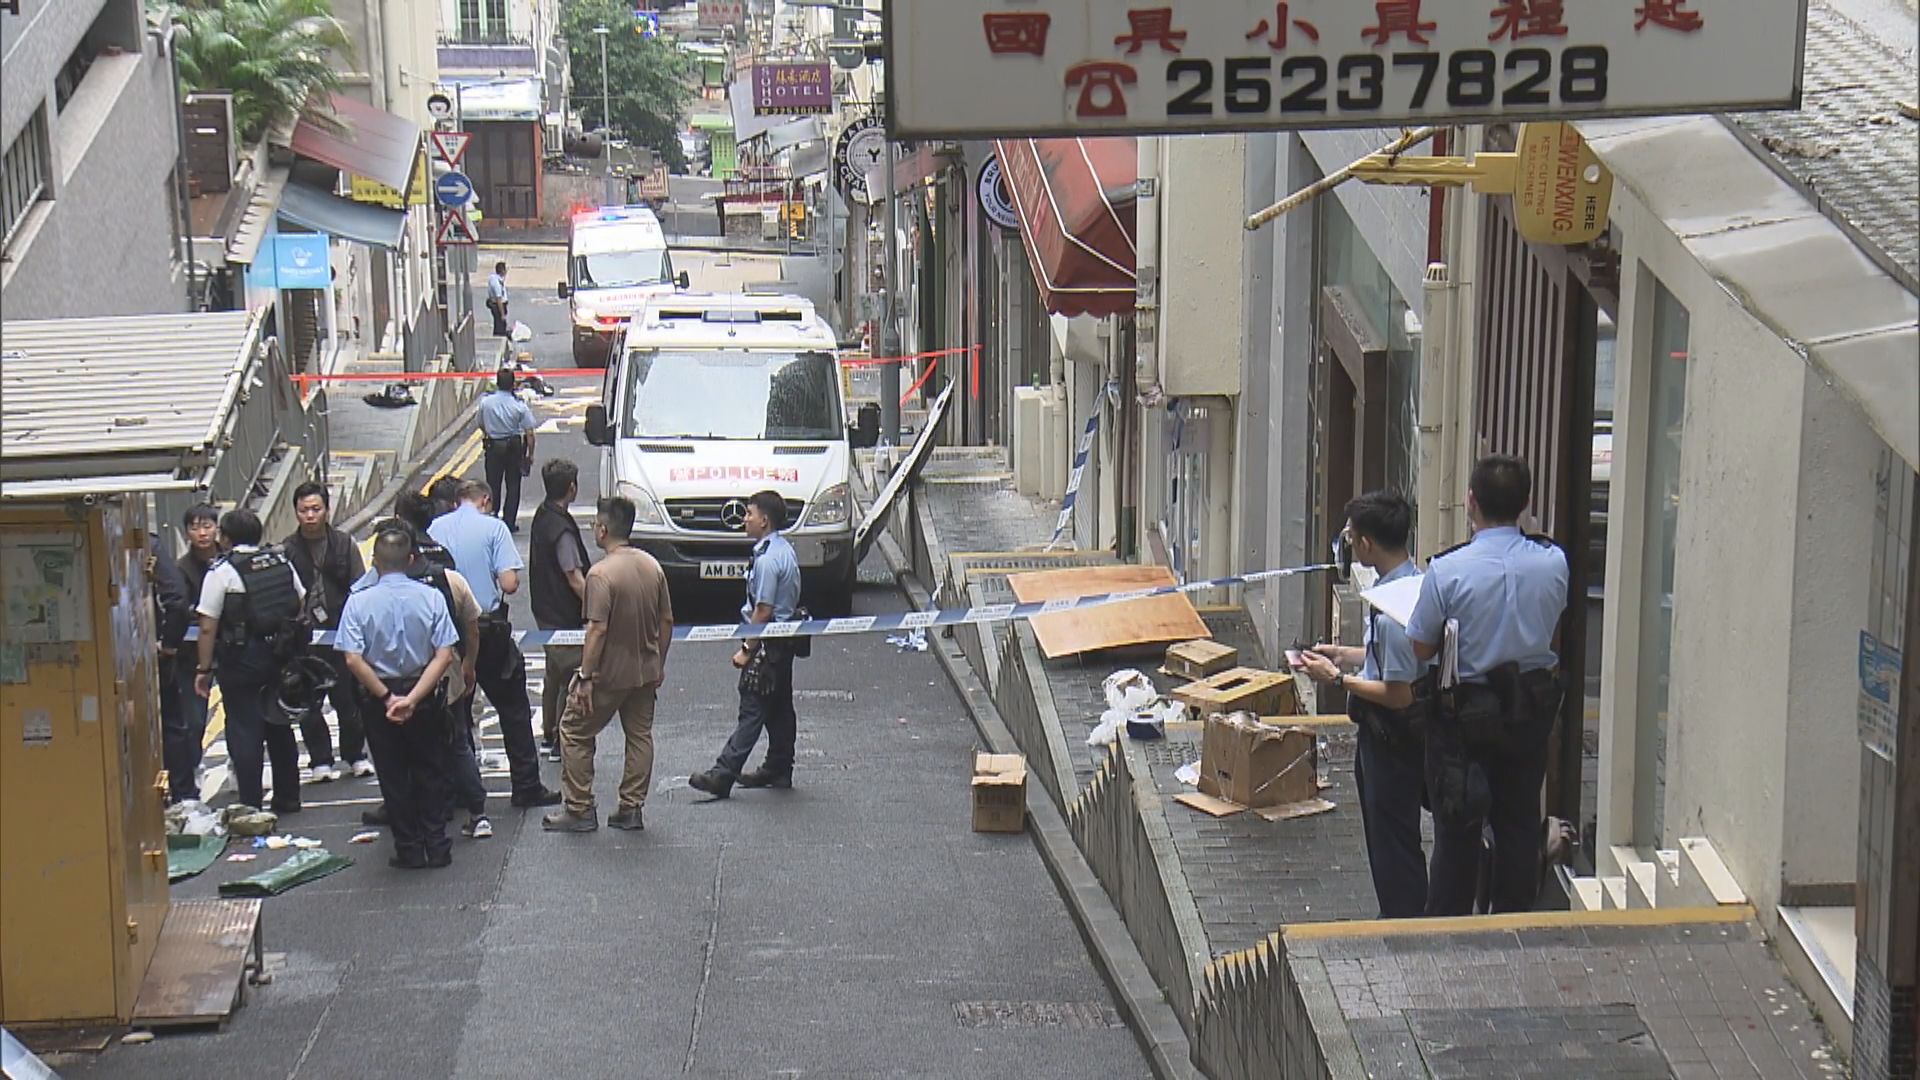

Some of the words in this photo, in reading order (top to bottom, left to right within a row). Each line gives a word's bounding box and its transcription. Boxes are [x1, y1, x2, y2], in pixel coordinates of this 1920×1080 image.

[1166, 45, 1610, 116] 25237828
[1541, 136, 1551, 155] KEY
[1524, 144, 1537, 208] MACHINES
[1536, 164, 1548, 216] CUTTING
[1584, 195, 1597, 231] HERE
[695, 466, 776, 481] POLICE
[704, 563, 723, 577] AM
[726, 563, 749, 578] 83
